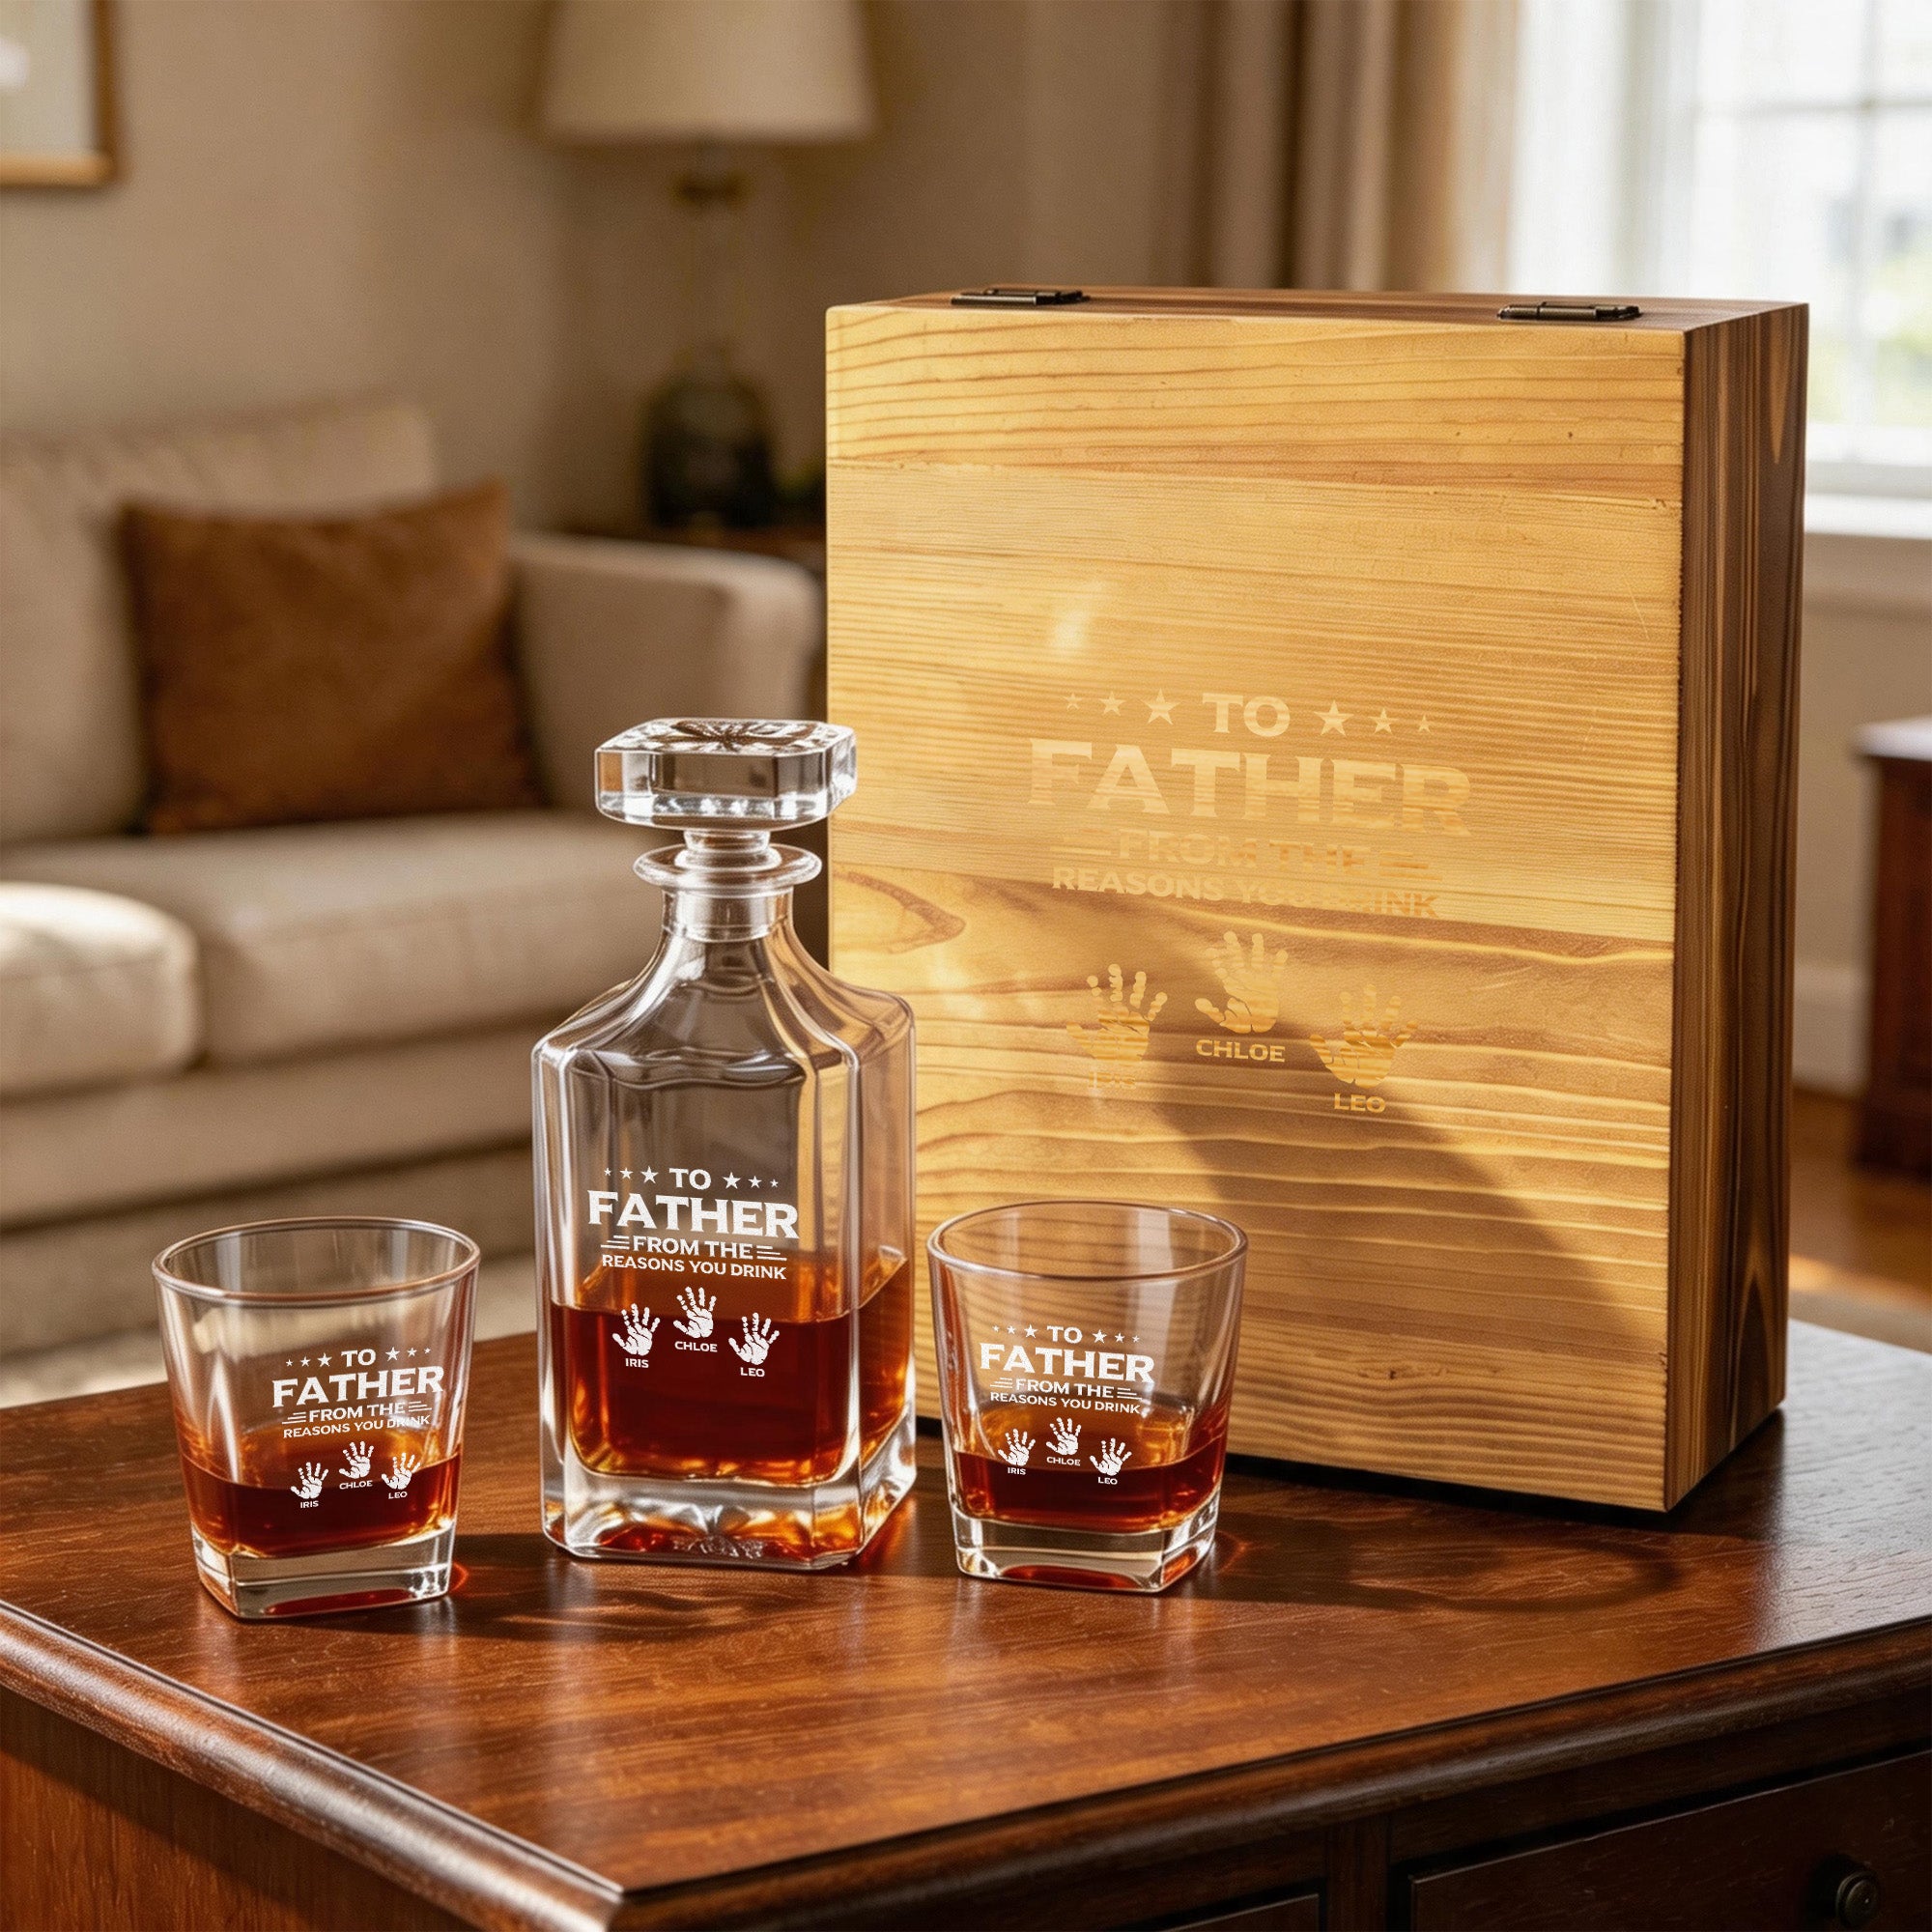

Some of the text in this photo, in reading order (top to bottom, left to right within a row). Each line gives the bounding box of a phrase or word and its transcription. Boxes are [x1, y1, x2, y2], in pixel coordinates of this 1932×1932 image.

[1202, 692, 1291, 737] TO
[1027, 737, 1473, 838] FATHER
[1118, 828, 1371, 877] FROM THE
[1052, 868, 1224, 902] REASONS
[1196, 1038, 1285, 1063] CHLOE
[1334, 1093, 1385, 1113] LEO
[669, 1168, 712, 1190] TO
[587, 1189, 800, 1239] FATHER
[633, 1236, 753, 1260] FROM THE
[602, 1254, 787, 1280] REASONS YOU DRINK
[1046, 1325, 1083, 1344] TO
[674, 1341, 718, 1352] CHLOE
[340, 1349, 376, 1367] TO
[625, 1357, 649, 1368] IRIS
[980, 1343, 1155, 1382] FATHER
[740, 1367, 765, 1378] LEO
[271, 1365, 444, 1408] FATHER
[1015, 1378, 1114, 1398] FROM THE
[308, 1403, 406, 1423] FROM THE
[990, 1392, 1141, 1414] REASONS YOU DRINK
[283, 1414, 431, 1438] REASONS YOU DRINK
[1007, 1466, 1026, 1475] IRIS
[1046, 1456, 1081, 1466] CHLOE
[339, 1479, 373, 1490] CHLOE
[1097, 1476, 1118, 1485] LEO
[299, 1500, 319, 1509] IRIS
[388, 1491, 408, 1499] LEO
